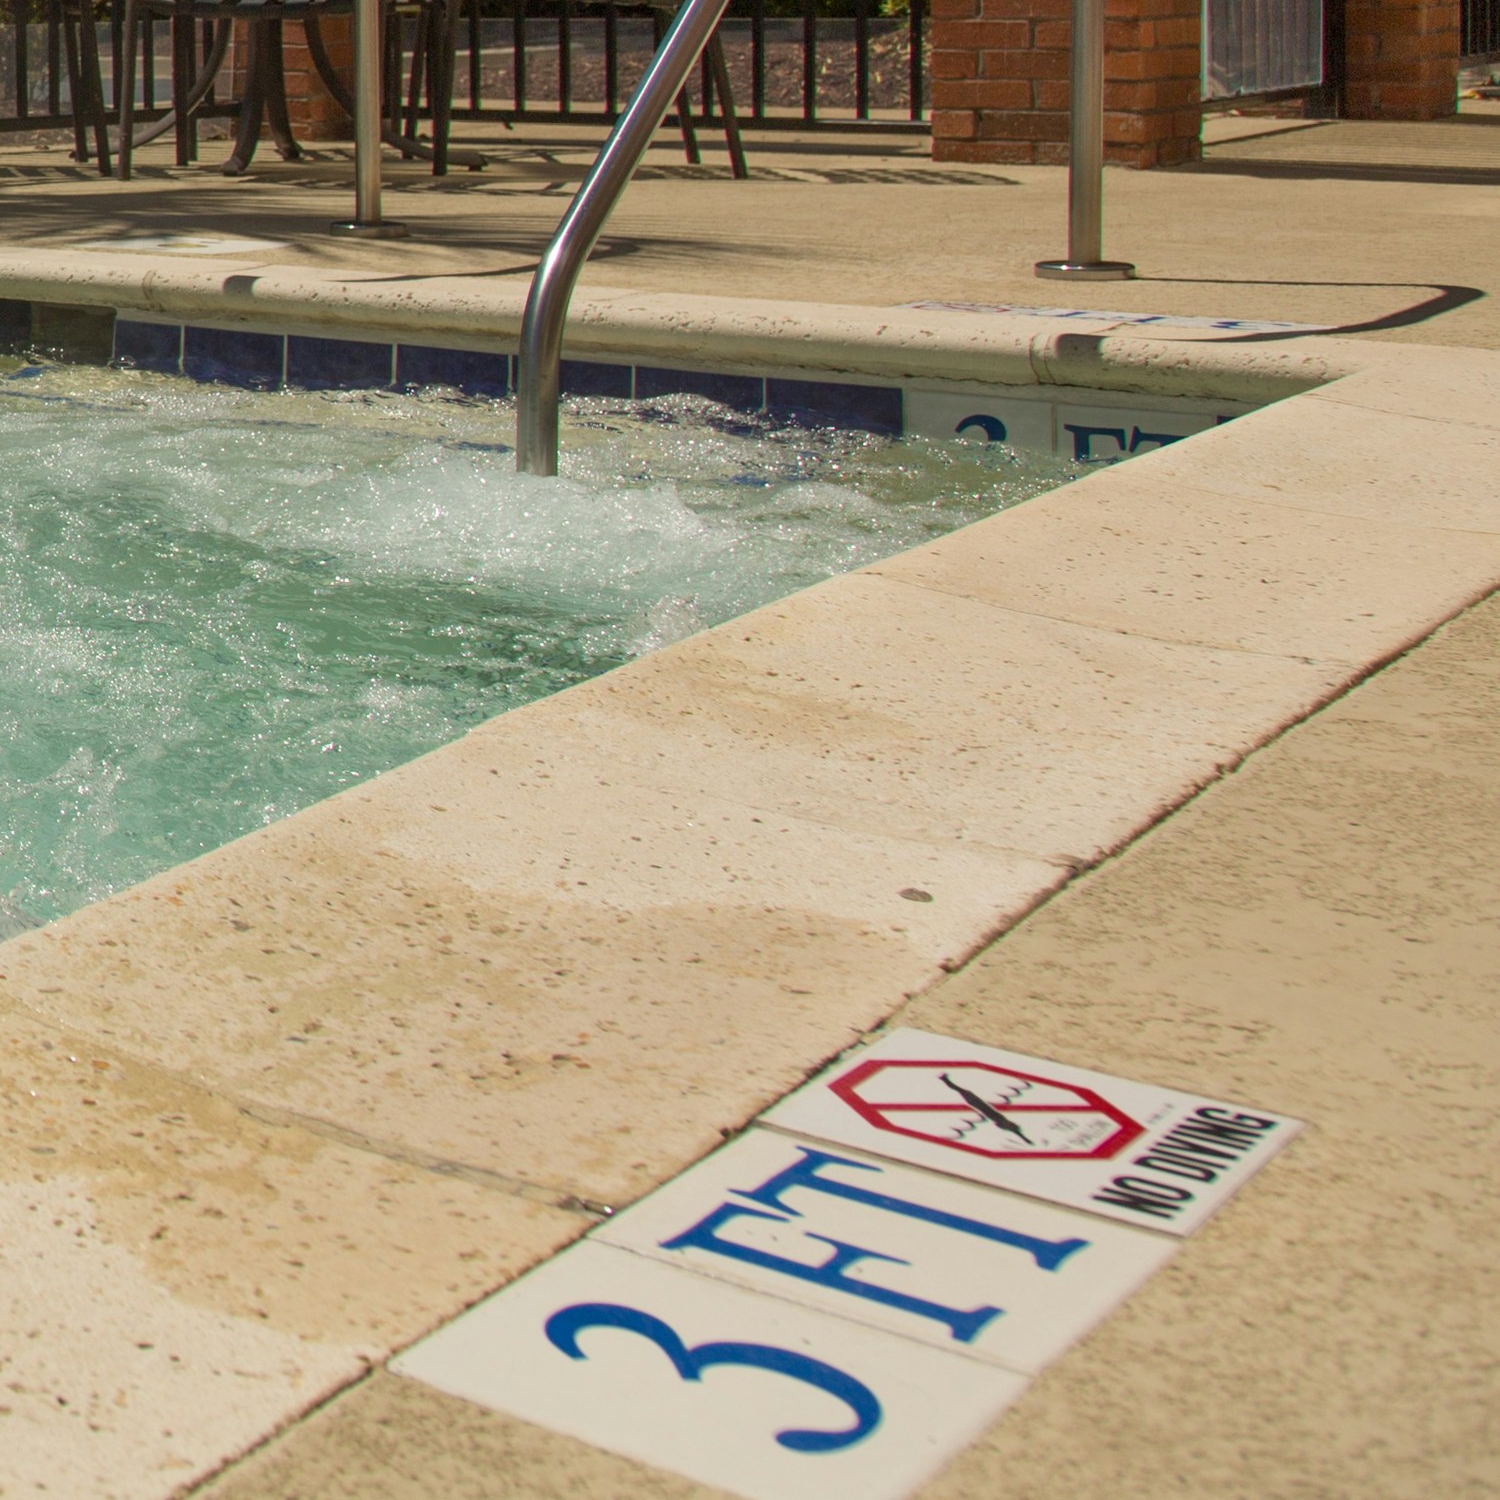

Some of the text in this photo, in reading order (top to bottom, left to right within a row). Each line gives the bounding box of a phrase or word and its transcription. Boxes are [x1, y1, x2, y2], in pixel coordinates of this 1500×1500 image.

[1091, 1106, 1280, 1220] NO DIVING
[543, 1146, 1093, 1455] 3 FT
